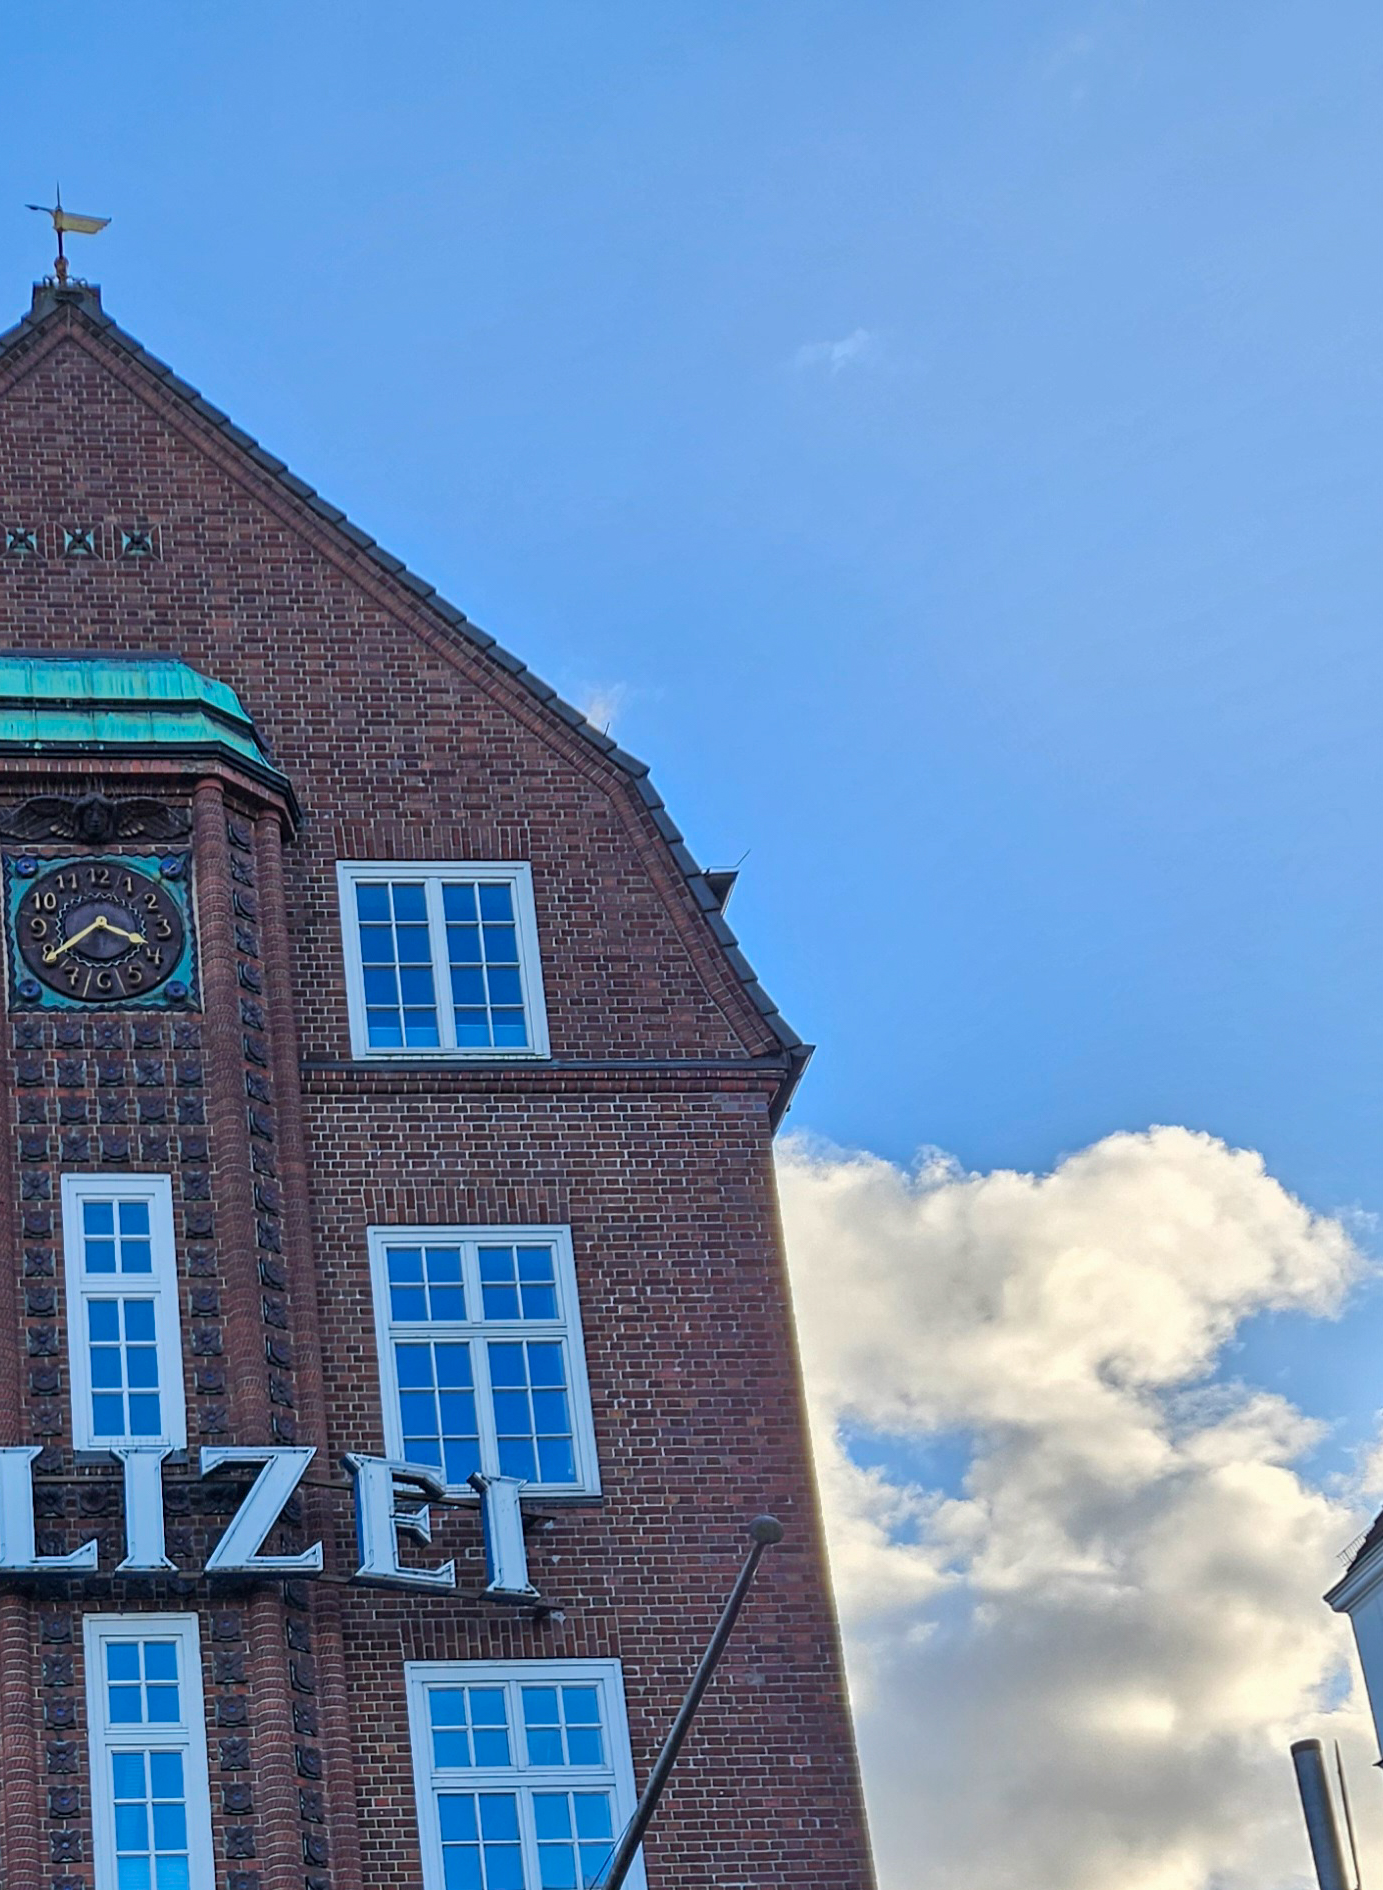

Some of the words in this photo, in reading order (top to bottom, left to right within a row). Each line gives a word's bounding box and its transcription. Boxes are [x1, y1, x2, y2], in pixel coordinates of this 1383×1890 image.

[56, 873, 78, 889] 11
[88, 868, 110, 884] 12
[124, 877, 134, 892] 1
[32, 892, 57, 910] 10
[144, 894, 159, 910] 2
[30, 918, 47, 935] 9
[157, 919, 172, 937] 3
[146, 947, 162, 966] 4
[64, 967, 79, 986] 7
[96, 971, 112, 988] 6
[128, 966, 143, 983] 5
